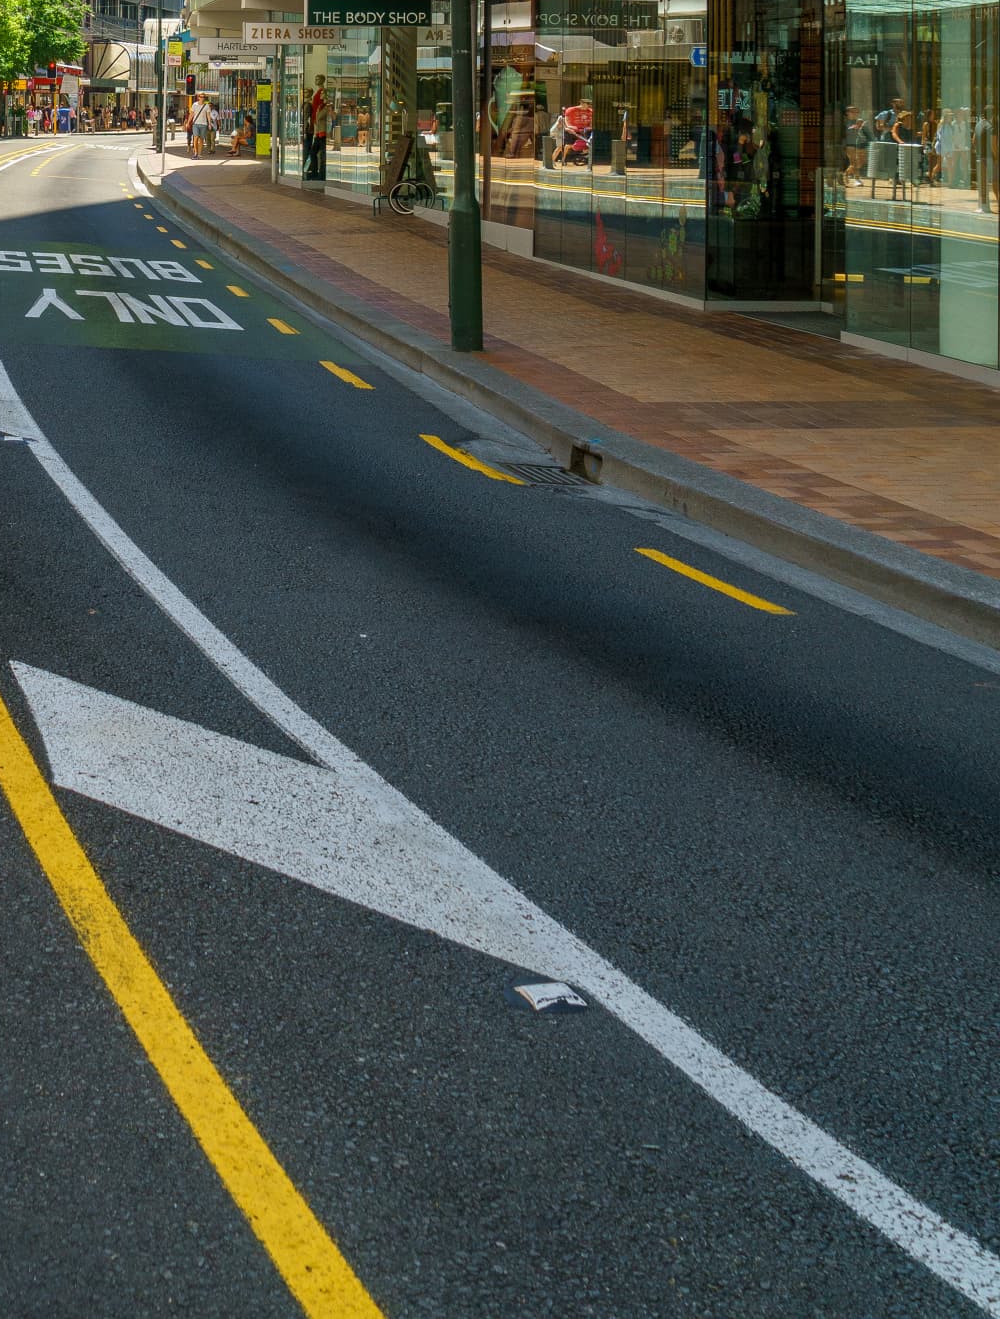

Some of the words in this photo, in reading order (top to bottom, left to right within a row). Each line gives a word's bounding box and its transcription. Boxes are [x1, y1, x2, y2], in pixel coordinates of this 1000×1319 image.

[312, 12, 341, 24] THE
[346, 11, 385, 24] BODY
[388, 12, 426, 24] SHOP
[251, 28, 292, 40] ZIERA
[298, 28, 336, 40] SHOES
[217, 42, 258, 52] HARTLEYS
[25, 288, 245, 331] ONLY
